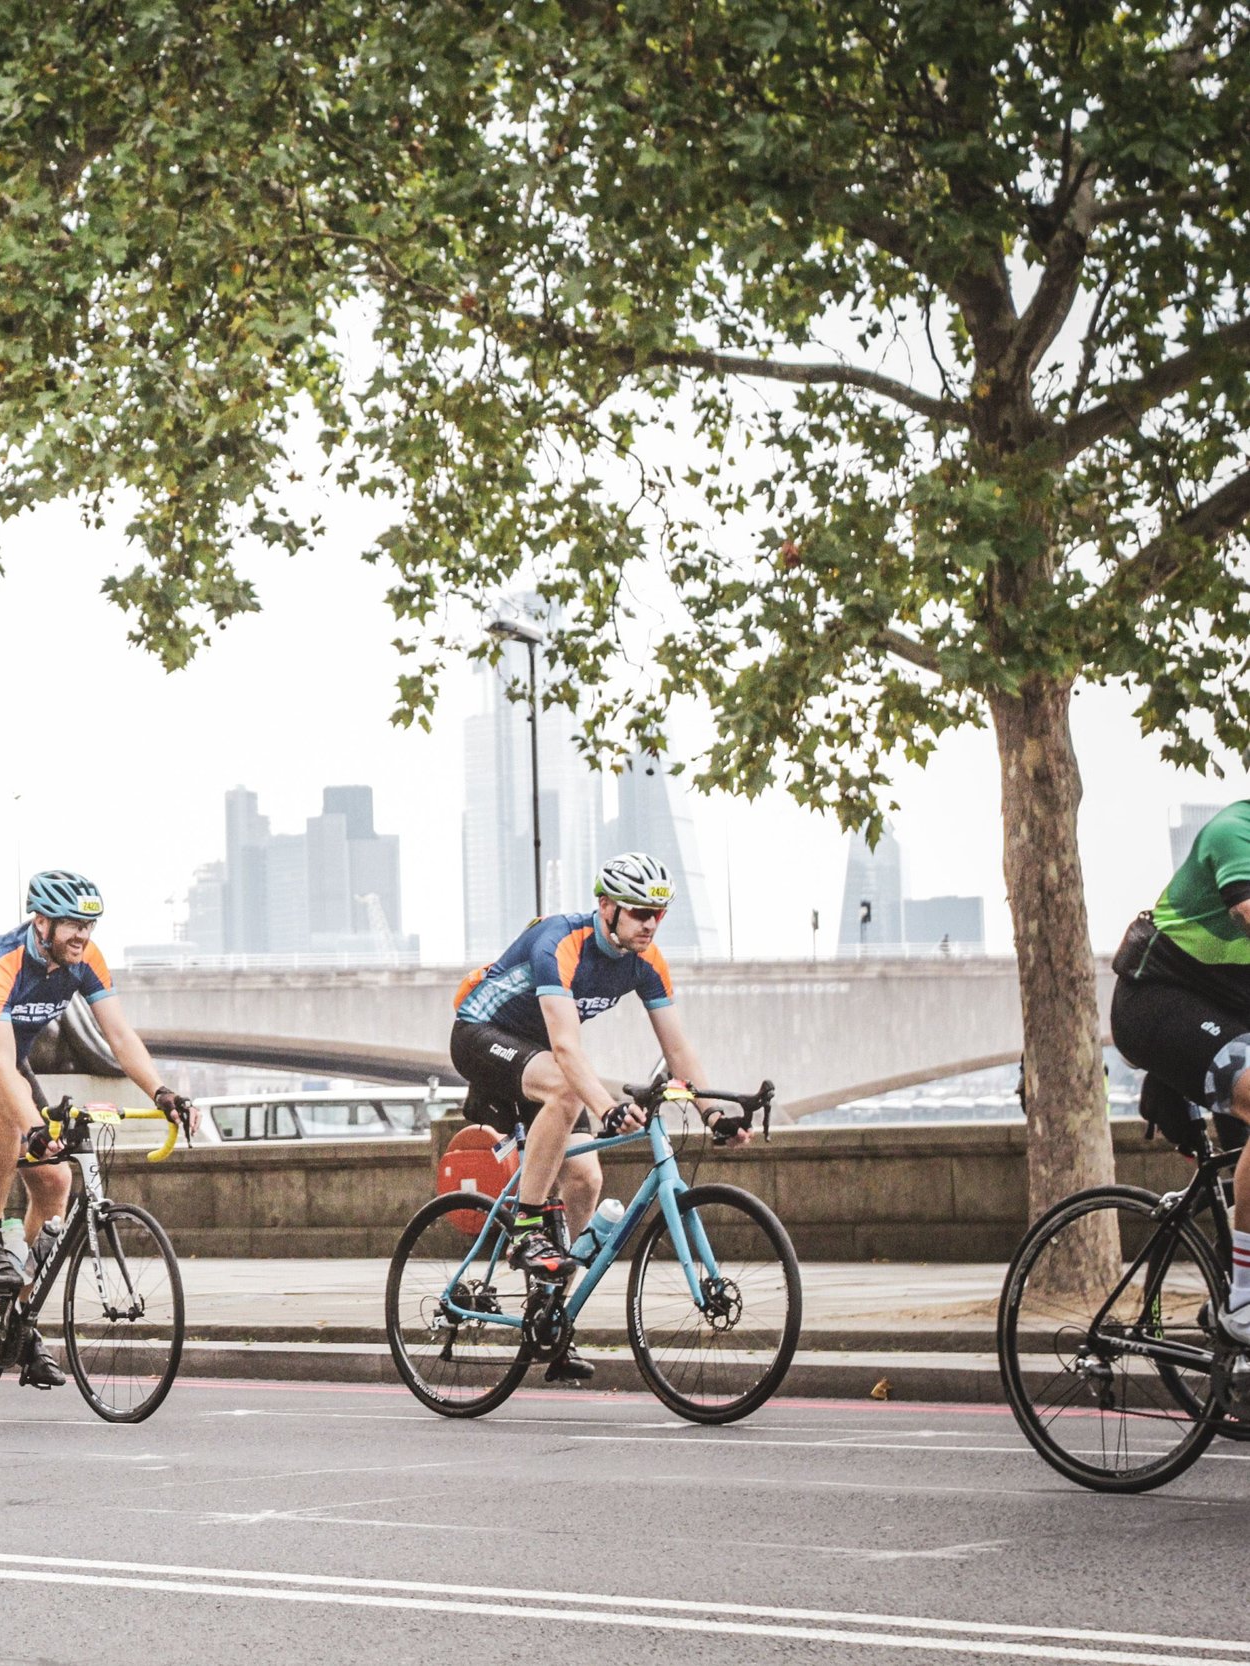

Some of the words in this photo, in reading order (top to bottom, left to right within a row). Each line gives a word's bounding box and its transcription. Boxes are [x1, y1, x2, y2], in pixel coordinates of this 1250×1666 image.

[675, 984, 760, 995] ATERLOO
[777, 982, 850, 994] BRIDGE
[1200, 1021, 1221, 1037] dhb
